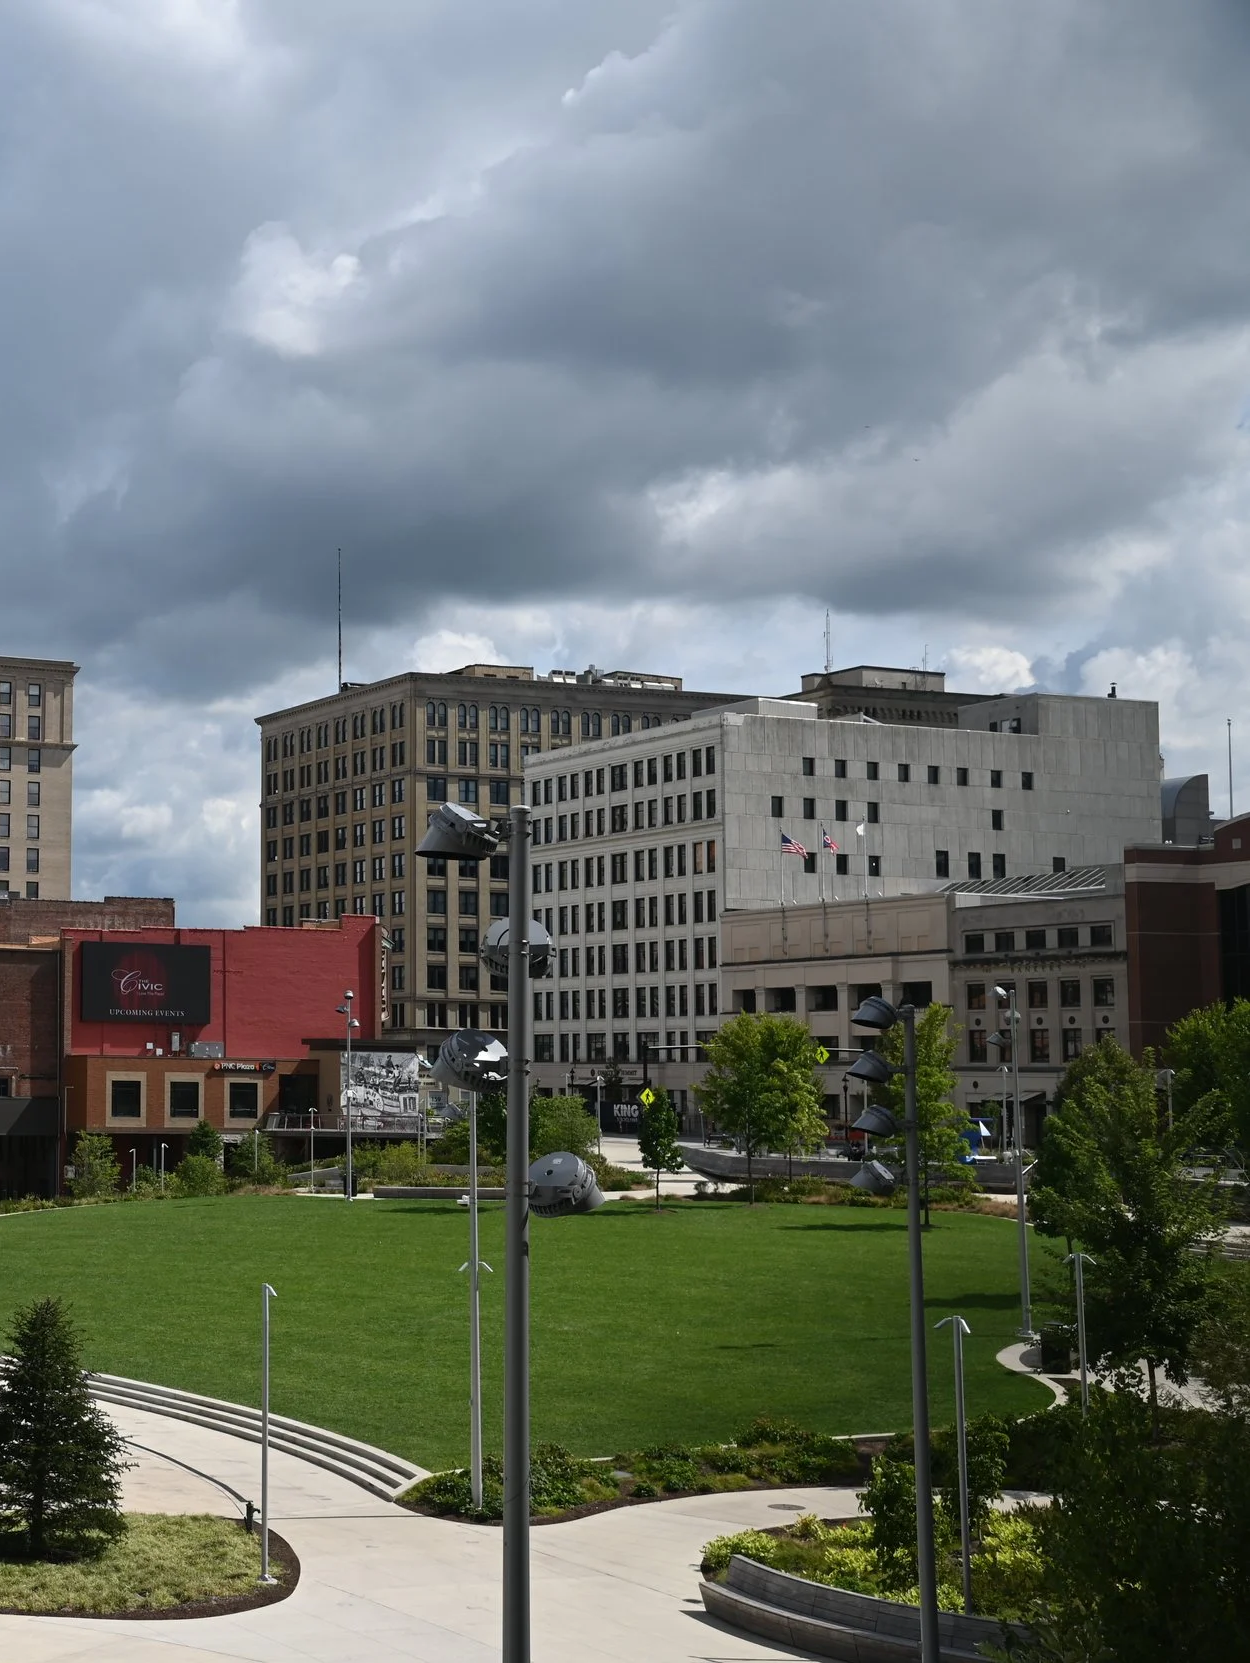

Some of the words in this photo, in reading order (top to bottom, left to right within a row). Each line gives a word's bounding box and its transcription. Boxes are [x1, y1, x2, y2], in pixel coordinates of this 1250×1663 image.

[109, 1008, 153, 1016] UPCOMING
[220, 1062, 236, 1070] PNC
[236, 1062, 255, 1070] Plaza
[613, 1103, 639, 1118] KING
